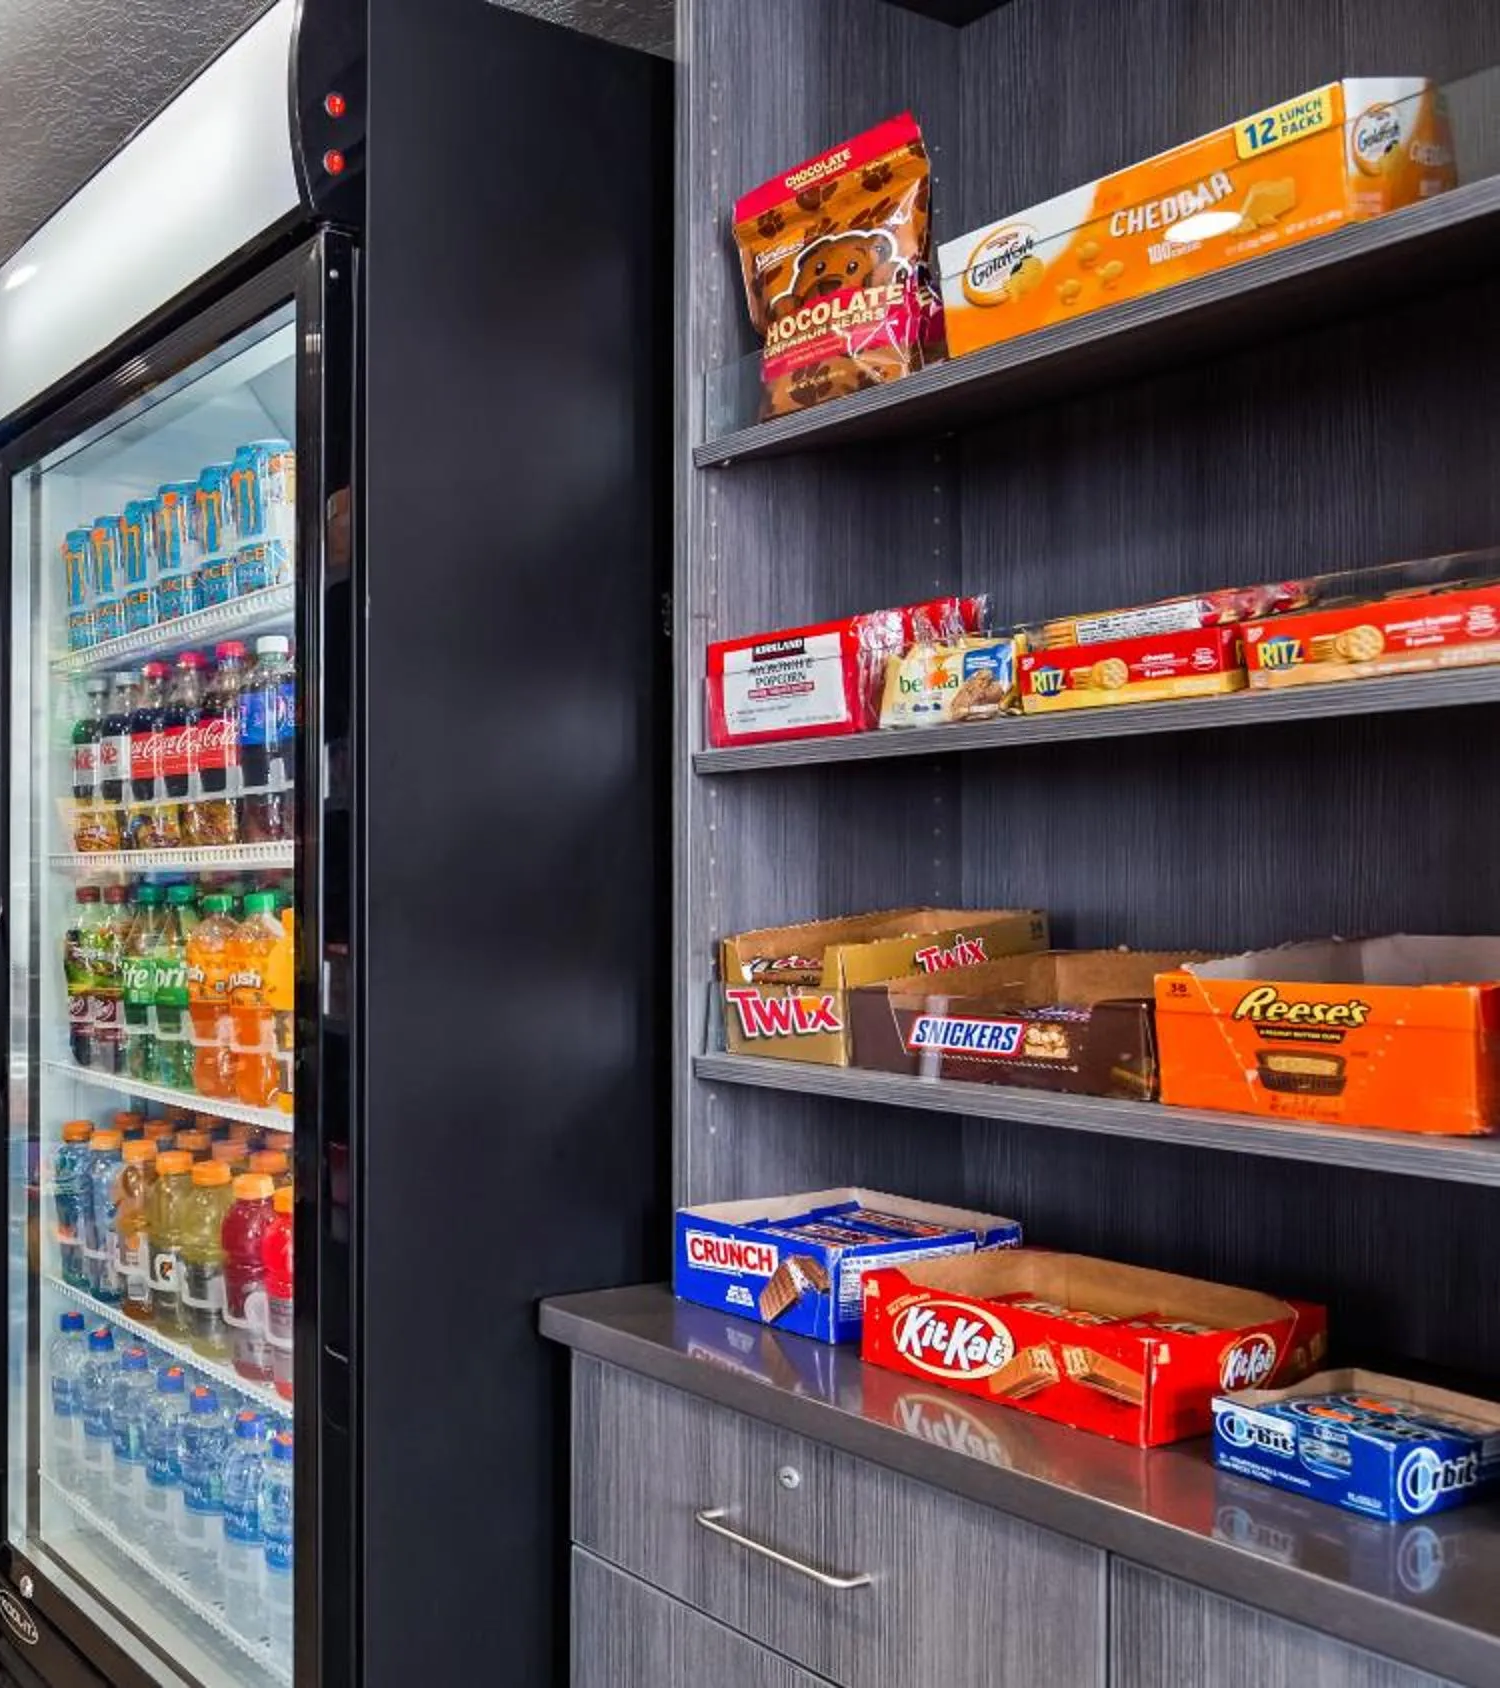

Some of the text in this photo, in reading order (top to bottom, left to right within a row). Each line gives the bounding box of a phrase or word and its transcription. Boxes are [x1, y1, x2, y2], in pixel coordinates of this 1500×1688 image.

[1243, 97, 1323, 153] 12 LUNCH
[1282, 112, 1324, 137] PACKS
[785, 148, 852, 189] CHOCOLATE
[1108, 169, 1235, 239] CHEDDAR
[972, 234, 1034, 287] Goldfish
[765, 281, 906, 348] HOCOLATE
[1257, 638, 1303, 669] RITZ
[754, 671, 807, 688] POPCORN
[1029, 669, 1067, 696] RITZ
[917, 934, 989, 974] Twix
[726, 986, 843, 1039] Twix
[1232, 985, 1371, 1027] Reese's
[913, 1018, 1020, 1051] SNICKERS
[689, 1236, 774, 1273] CRUNCH
[898, 1306, 1007, 1372] KitKat
[1222, 1343, 1275, 1390] KitKat
[1215, 1410, 1296, 1458] Orbit
[1397, 1446, 1479, 1515] Orbit
